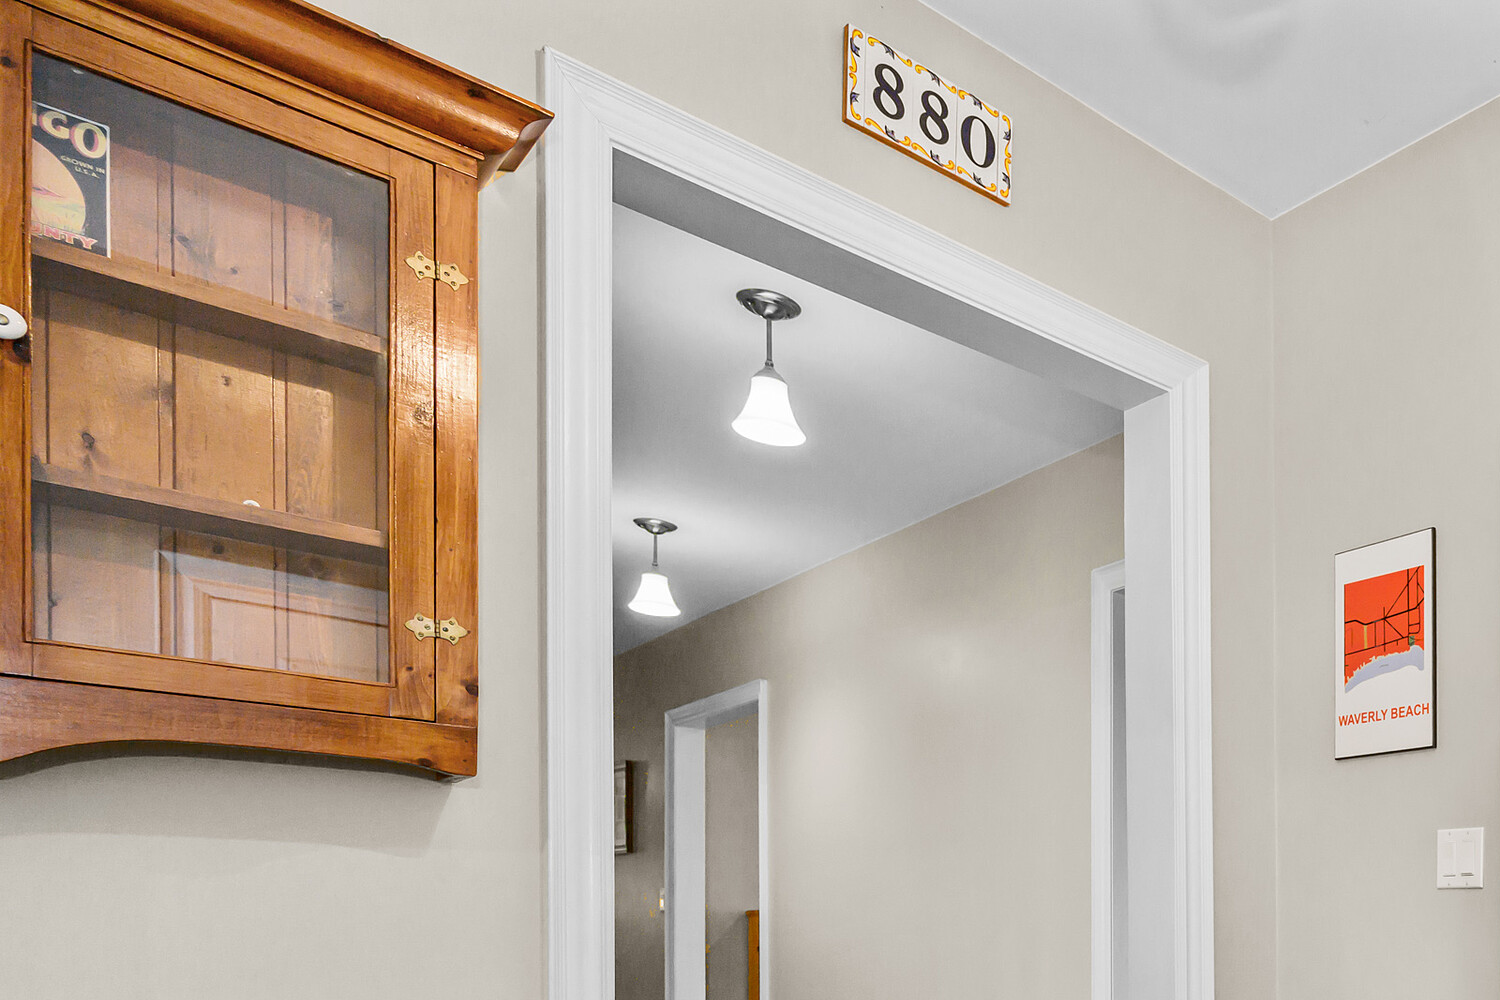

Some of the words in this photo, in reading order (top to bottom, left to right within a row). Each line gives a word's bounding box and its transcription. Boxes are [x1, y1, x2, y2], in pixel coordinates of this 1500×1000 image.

[872, 63, 996, 169] 880
[95, 166, 106, 174] IN
[1338, 708, 1388, 727] WAVERLY
[1390, 702, 1430, 719] BEACH
